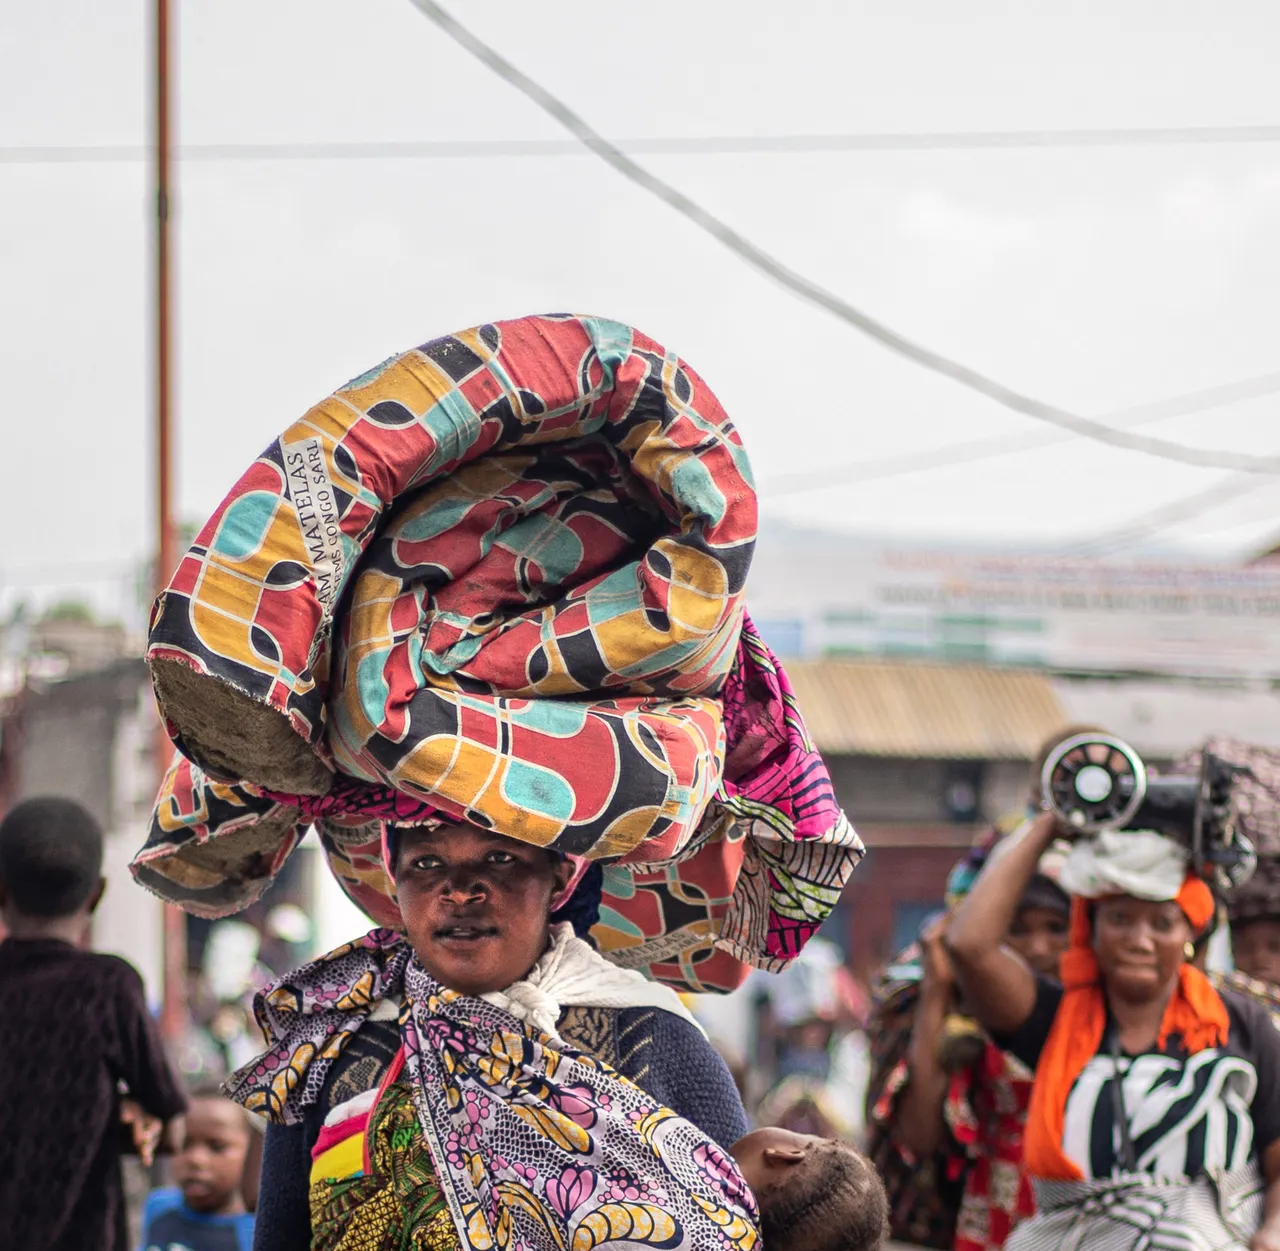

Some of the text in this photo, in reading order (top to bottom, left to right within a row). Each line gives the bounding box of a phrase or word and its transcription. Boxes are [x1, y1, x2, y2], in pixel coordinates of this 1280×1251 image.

[307, 439, 326, 485] SARL
[287, 452, 327, 564] MATELAS
[317, 490, 338, 546] CONGO
